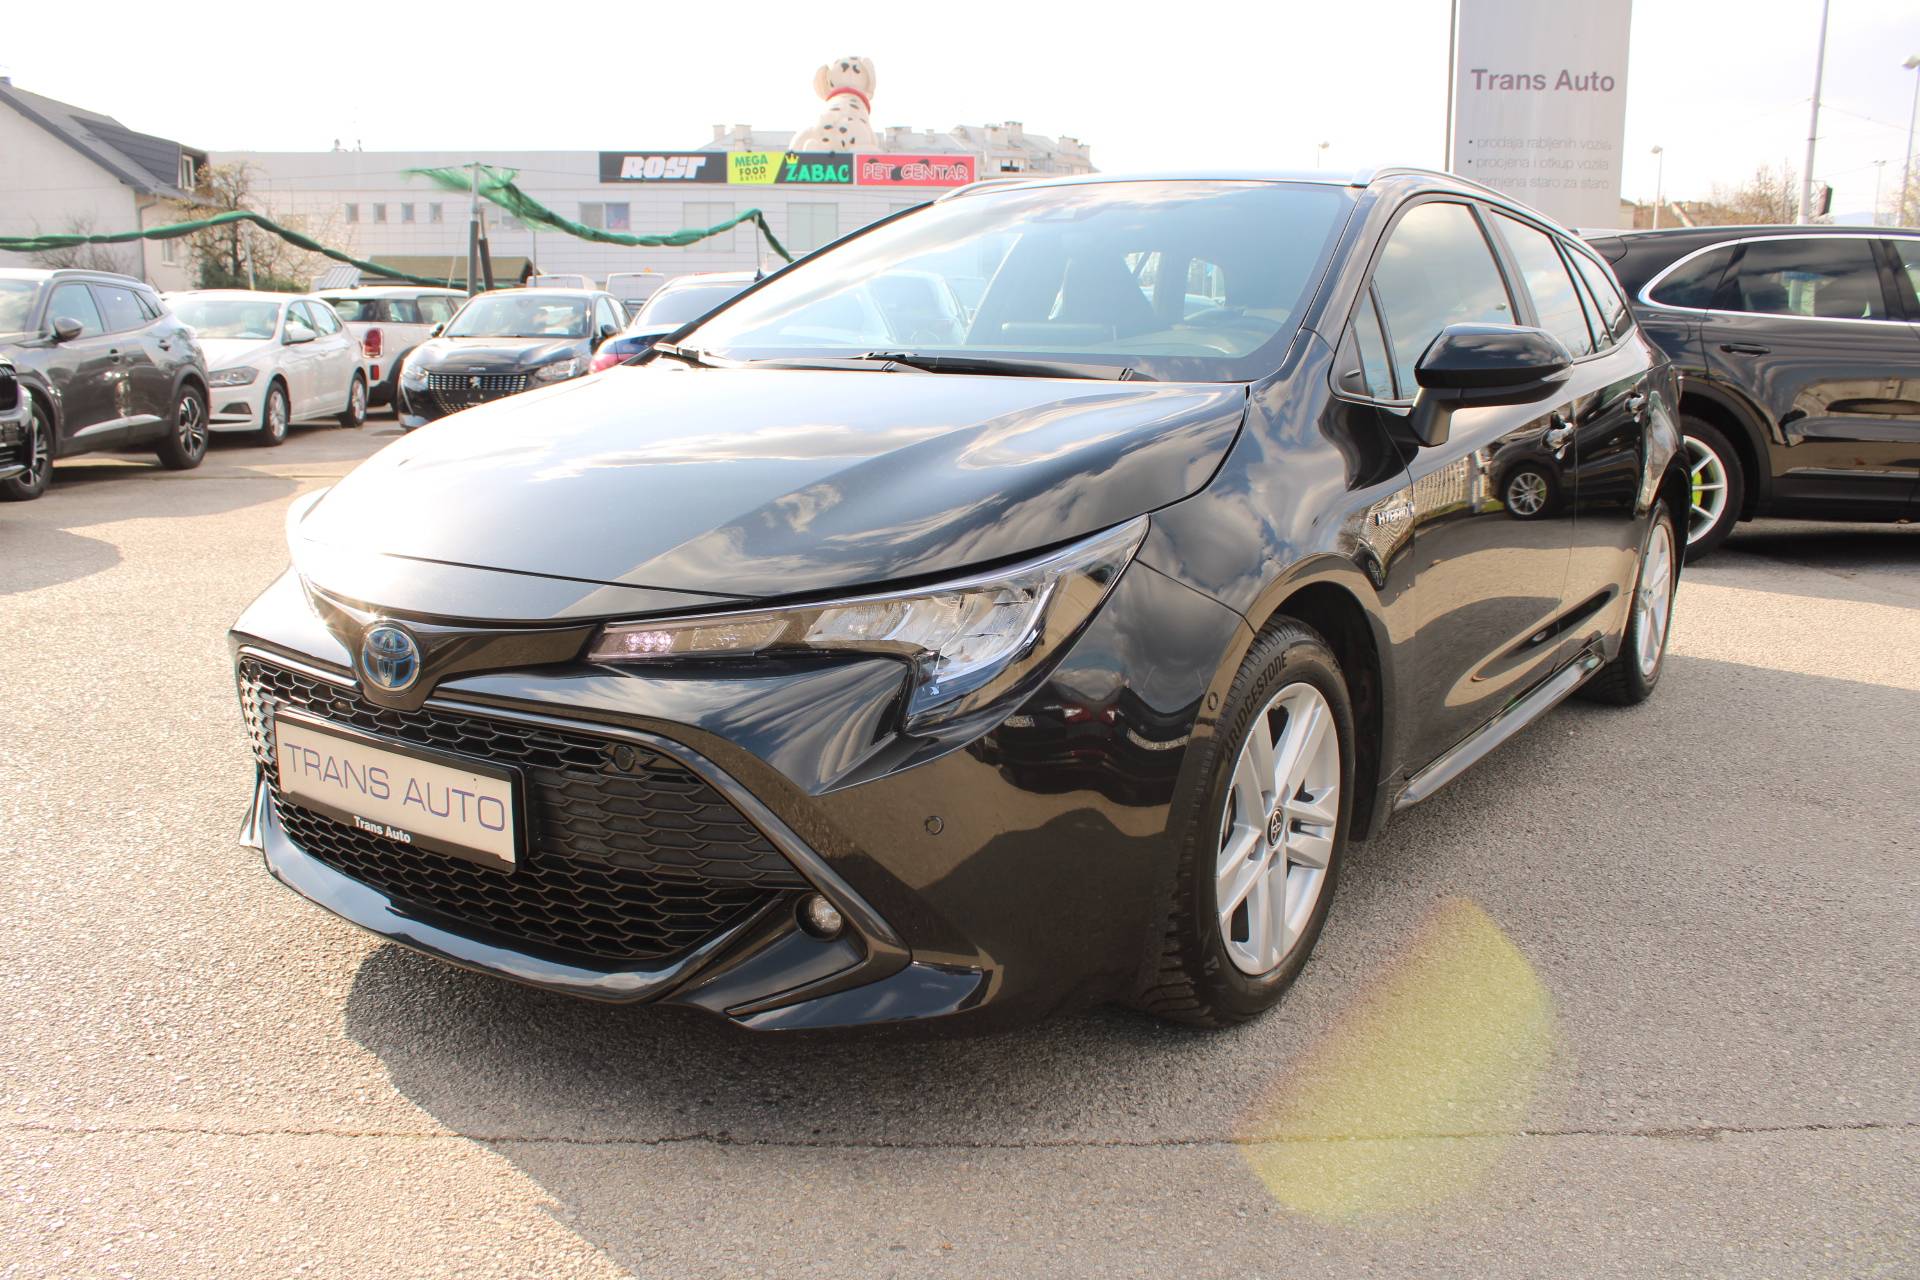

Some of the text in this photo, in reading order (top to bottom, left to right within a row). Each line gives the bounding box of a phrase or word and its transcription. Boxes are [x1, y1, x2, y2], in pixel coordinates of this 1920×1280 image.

[1471, 69, 1615, 92] Trans Auto
[620, 156, 706, 179] ROST
[735, 155, 768, 167] MEGA
[739, 166, 766, 176] FOOD
[863, 163, 968, 181] PET CENTAR
[284, 743, 505, 832] TRANS AUTO
[354, 815, 411, 844] Trans Auto
